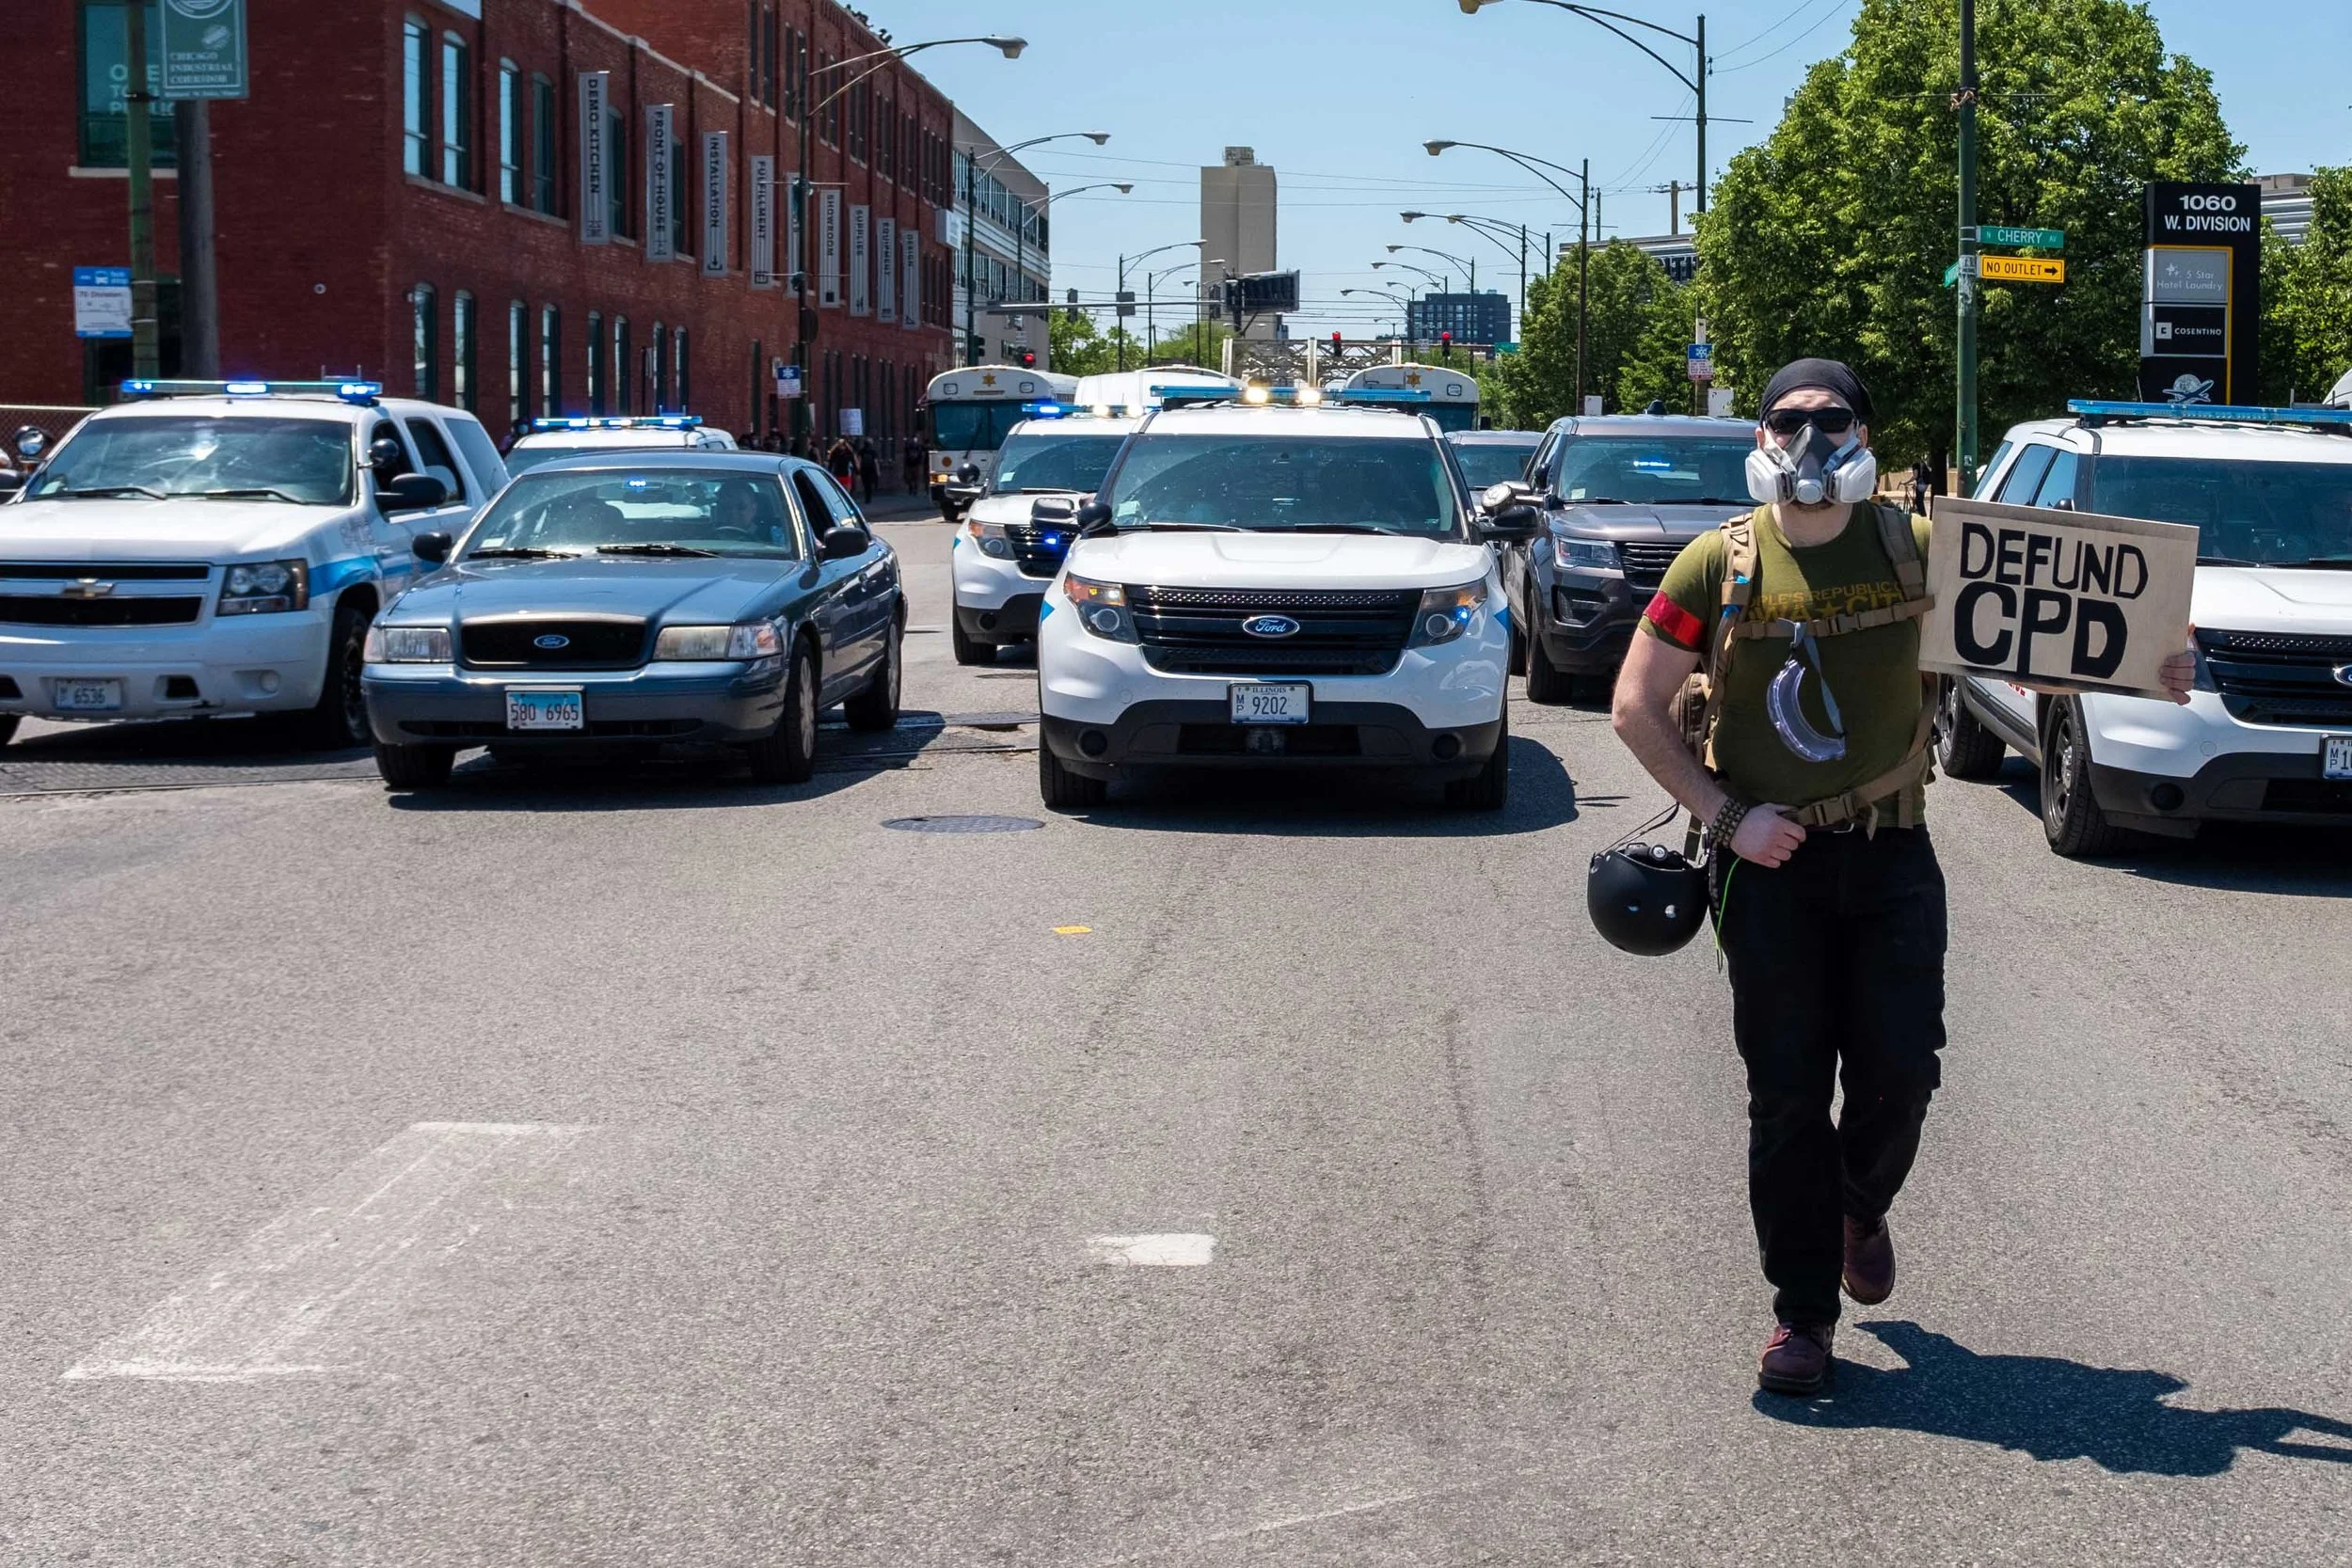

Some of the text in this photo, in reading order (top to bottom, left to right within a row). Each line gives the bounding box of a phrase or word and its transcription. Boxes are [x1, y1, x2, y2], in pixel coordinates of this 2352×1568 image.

[588, 79, 600, 194] DEMO KITCHEN
[655, 111, 666, 232] FRONT OF HOUSE
[709, 137, 720, 228] INSTALLATION
[756, 161, 767, 239] FULFILLMENT
[2179, 195, 2236, 211] 1060
[826, 195, 835, 257] SHOWROOM
[855, 210, 864, 257] SUPPLIES
[2164, 214, 2250, 231] W. DIVISION
[882, 222, 891, 277] EQUIPMENT
[1997, 230, 2042, 244] CHERRY
[906, 234, 914, 267] DESIGN
[1986, 262, 2042, 276] NO OUTLET
[2185, 270, 2214, 279] 5 Star
[2156, 280, 2223, 292] Hotel Laundry
[2174, 327, 2222, 336] COSENTINO
[1960, 522, 2149, 600] DEFUND
[1810, 581, 1890, 601] REPUBLIC
[1953, 581, 2128, 679] CPD
[511, 704, 579, 721] 580 6965
[1252, 696, 1288, 715] 9202
